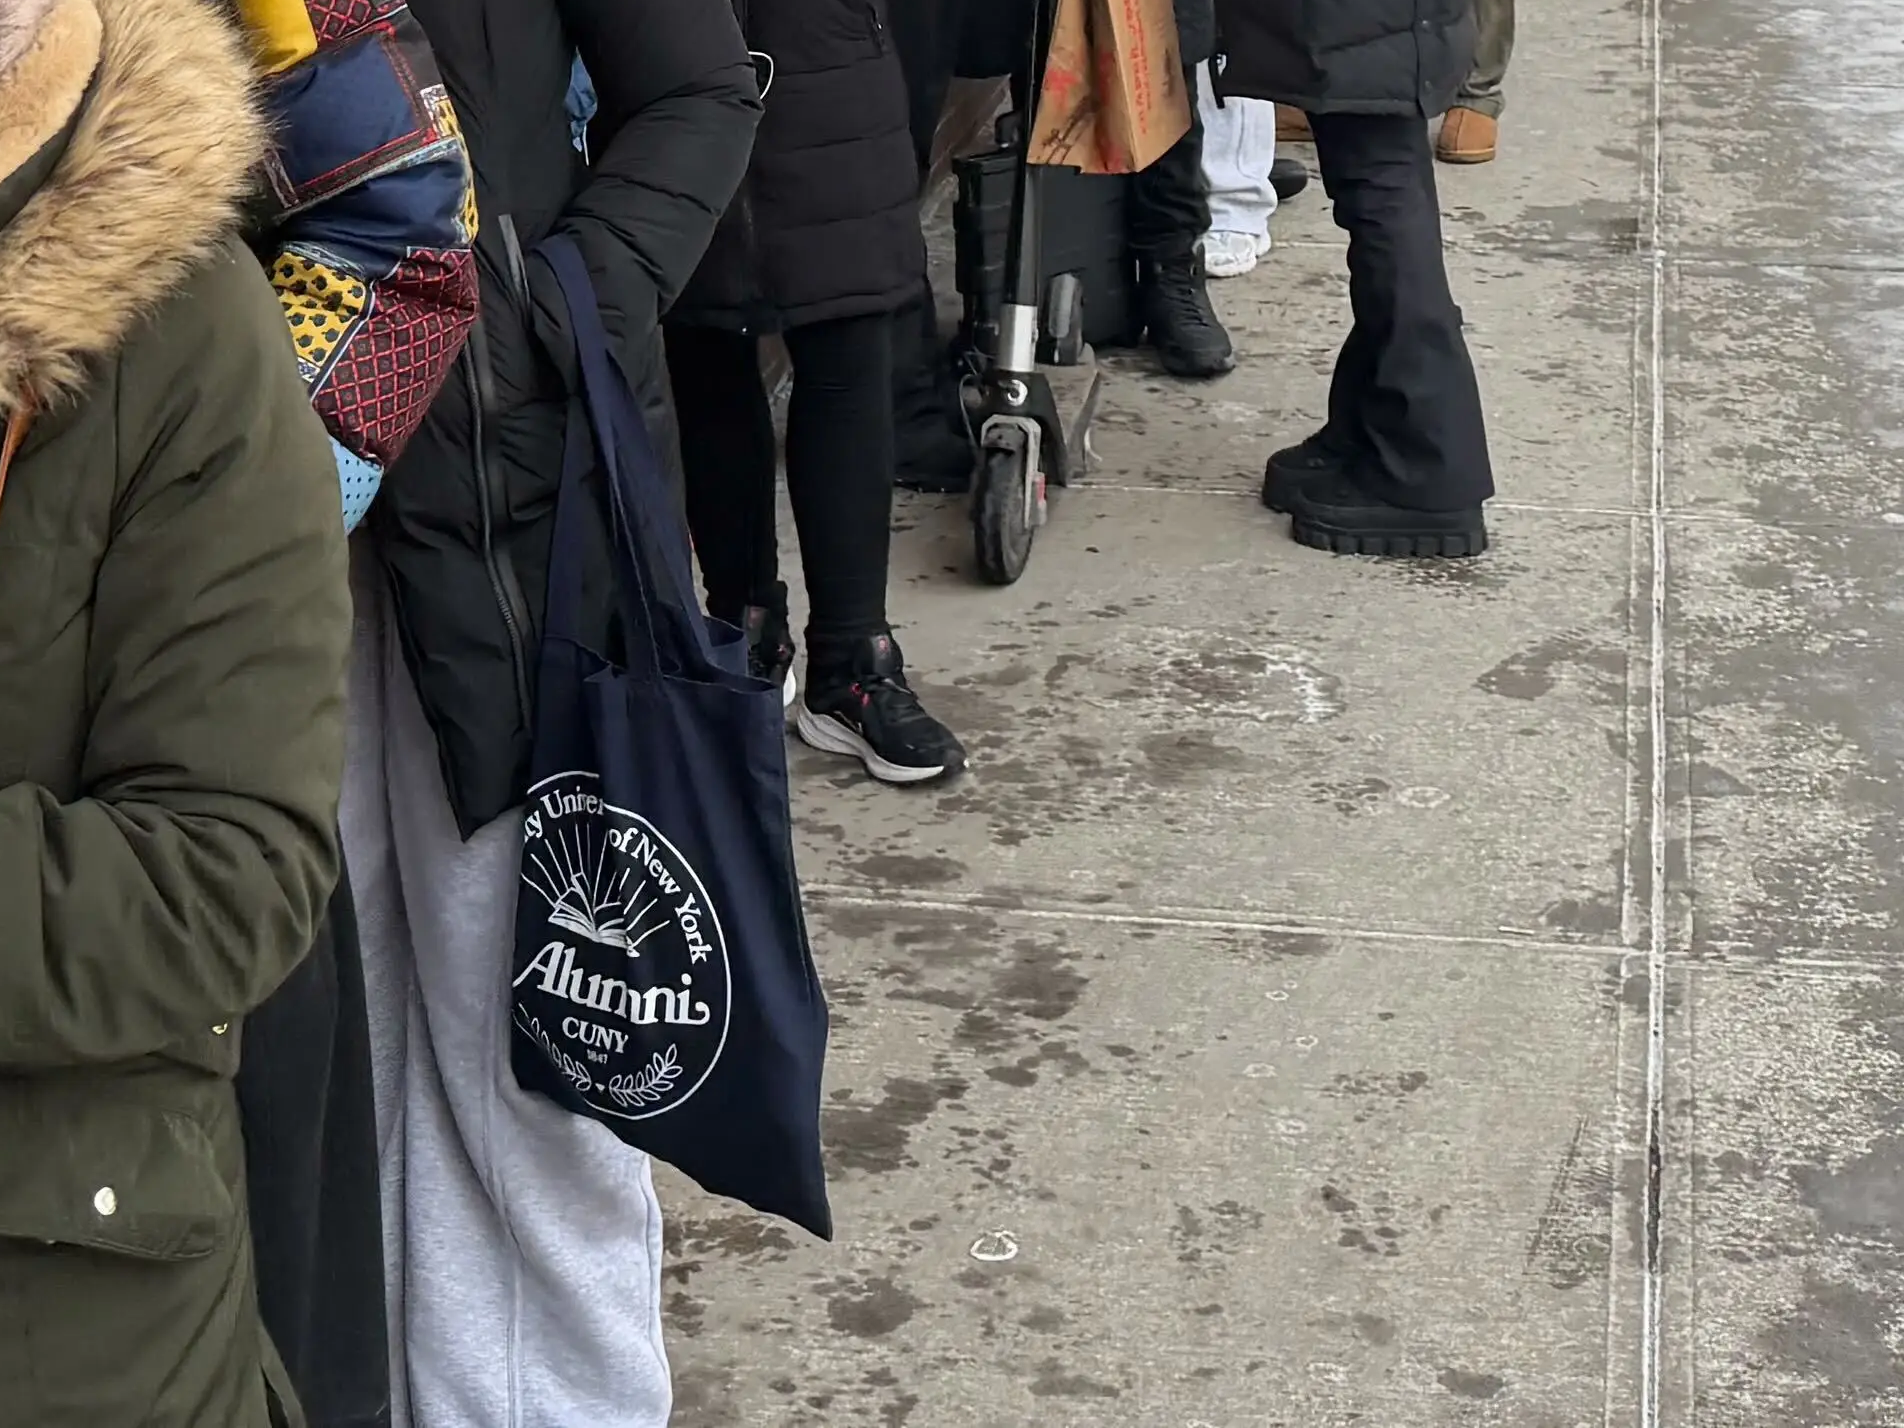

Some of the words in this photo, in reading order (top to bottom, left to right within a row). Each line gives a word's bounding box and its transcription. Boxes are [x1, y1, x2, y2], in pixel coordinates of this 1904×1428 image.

[608, 826, 637, 853] of
[631, 834, 682, 896] New
[674, 891, 713, 966] York
[511, 940, 711, 1026] Alumni
[561, 1016, 629, 1055] CUNY
